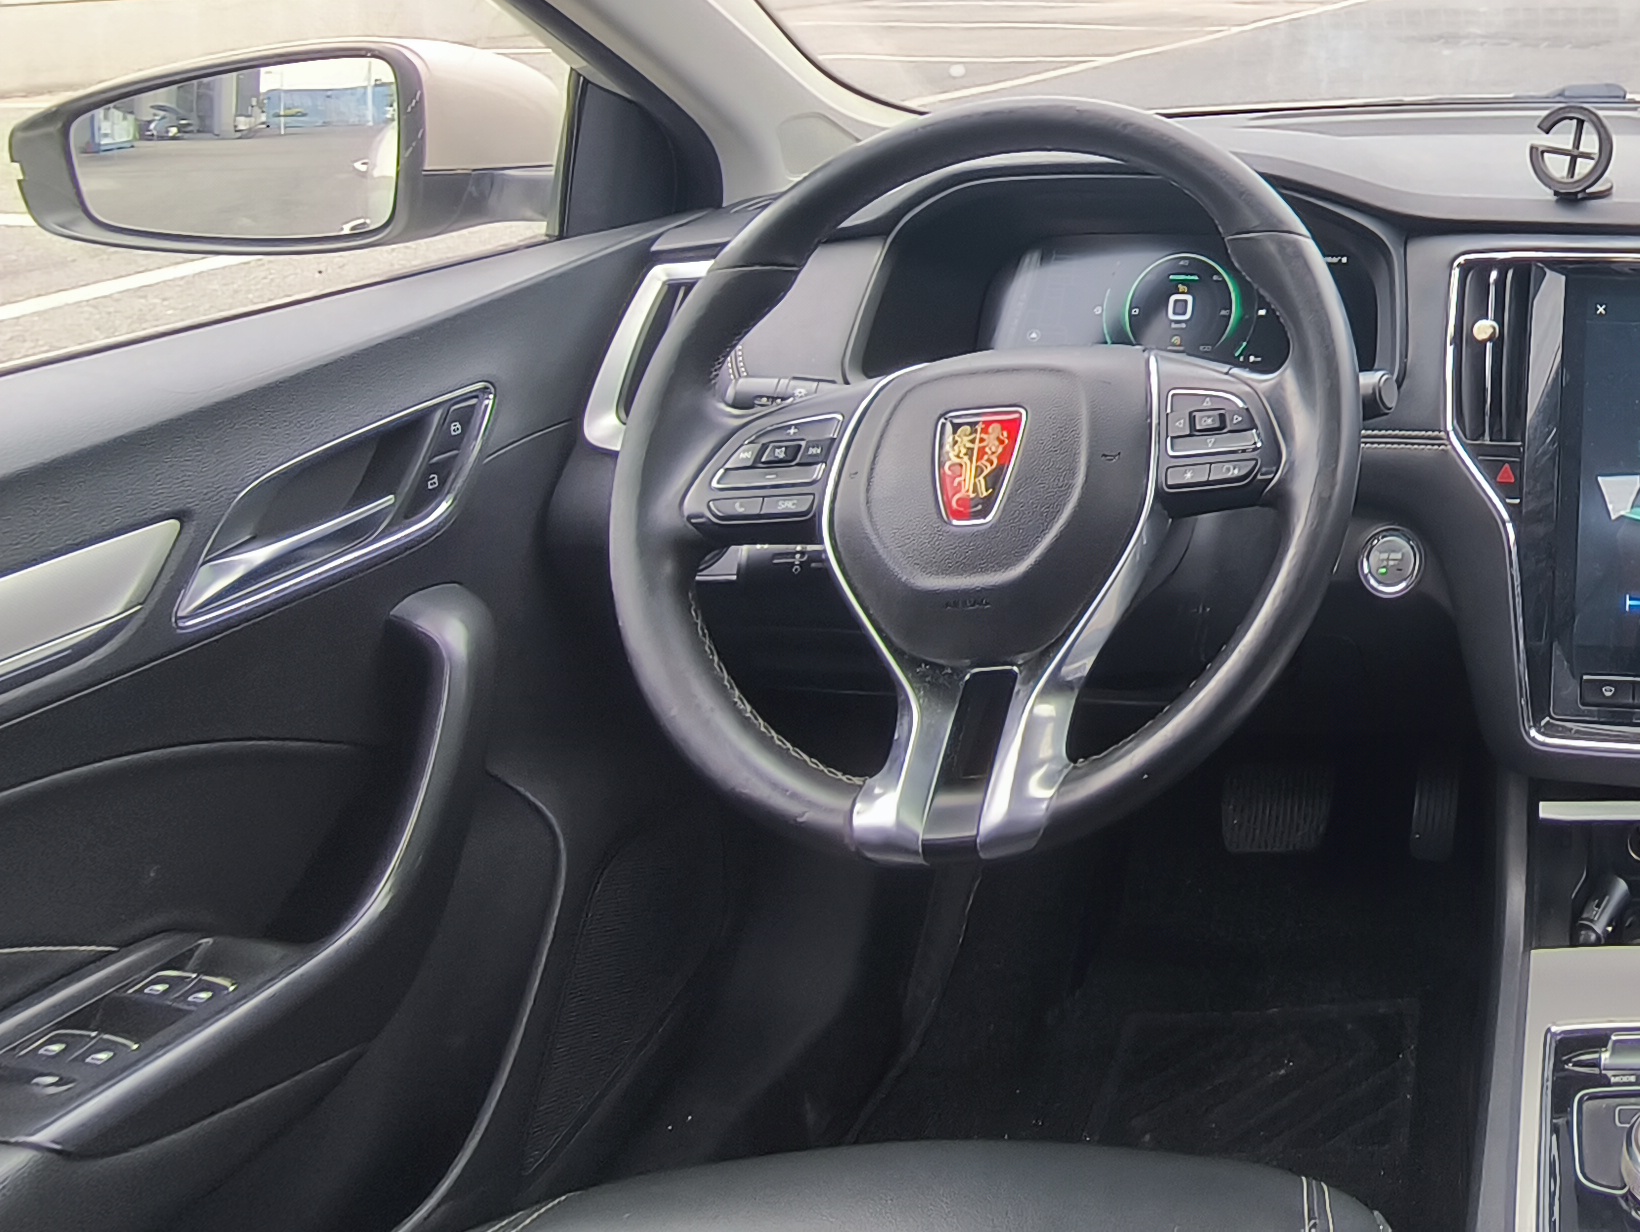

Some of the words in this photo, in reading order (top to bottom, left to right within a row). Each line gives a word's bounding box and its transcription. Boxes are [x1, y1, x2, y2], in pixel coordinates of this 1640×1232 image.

[1168, 293, 1193, 321] 0
[1202, 416, 1214, 425] OK
[777, 499, 797, 510] SRC
[1610, 1074, 1637, 1083] MODE
